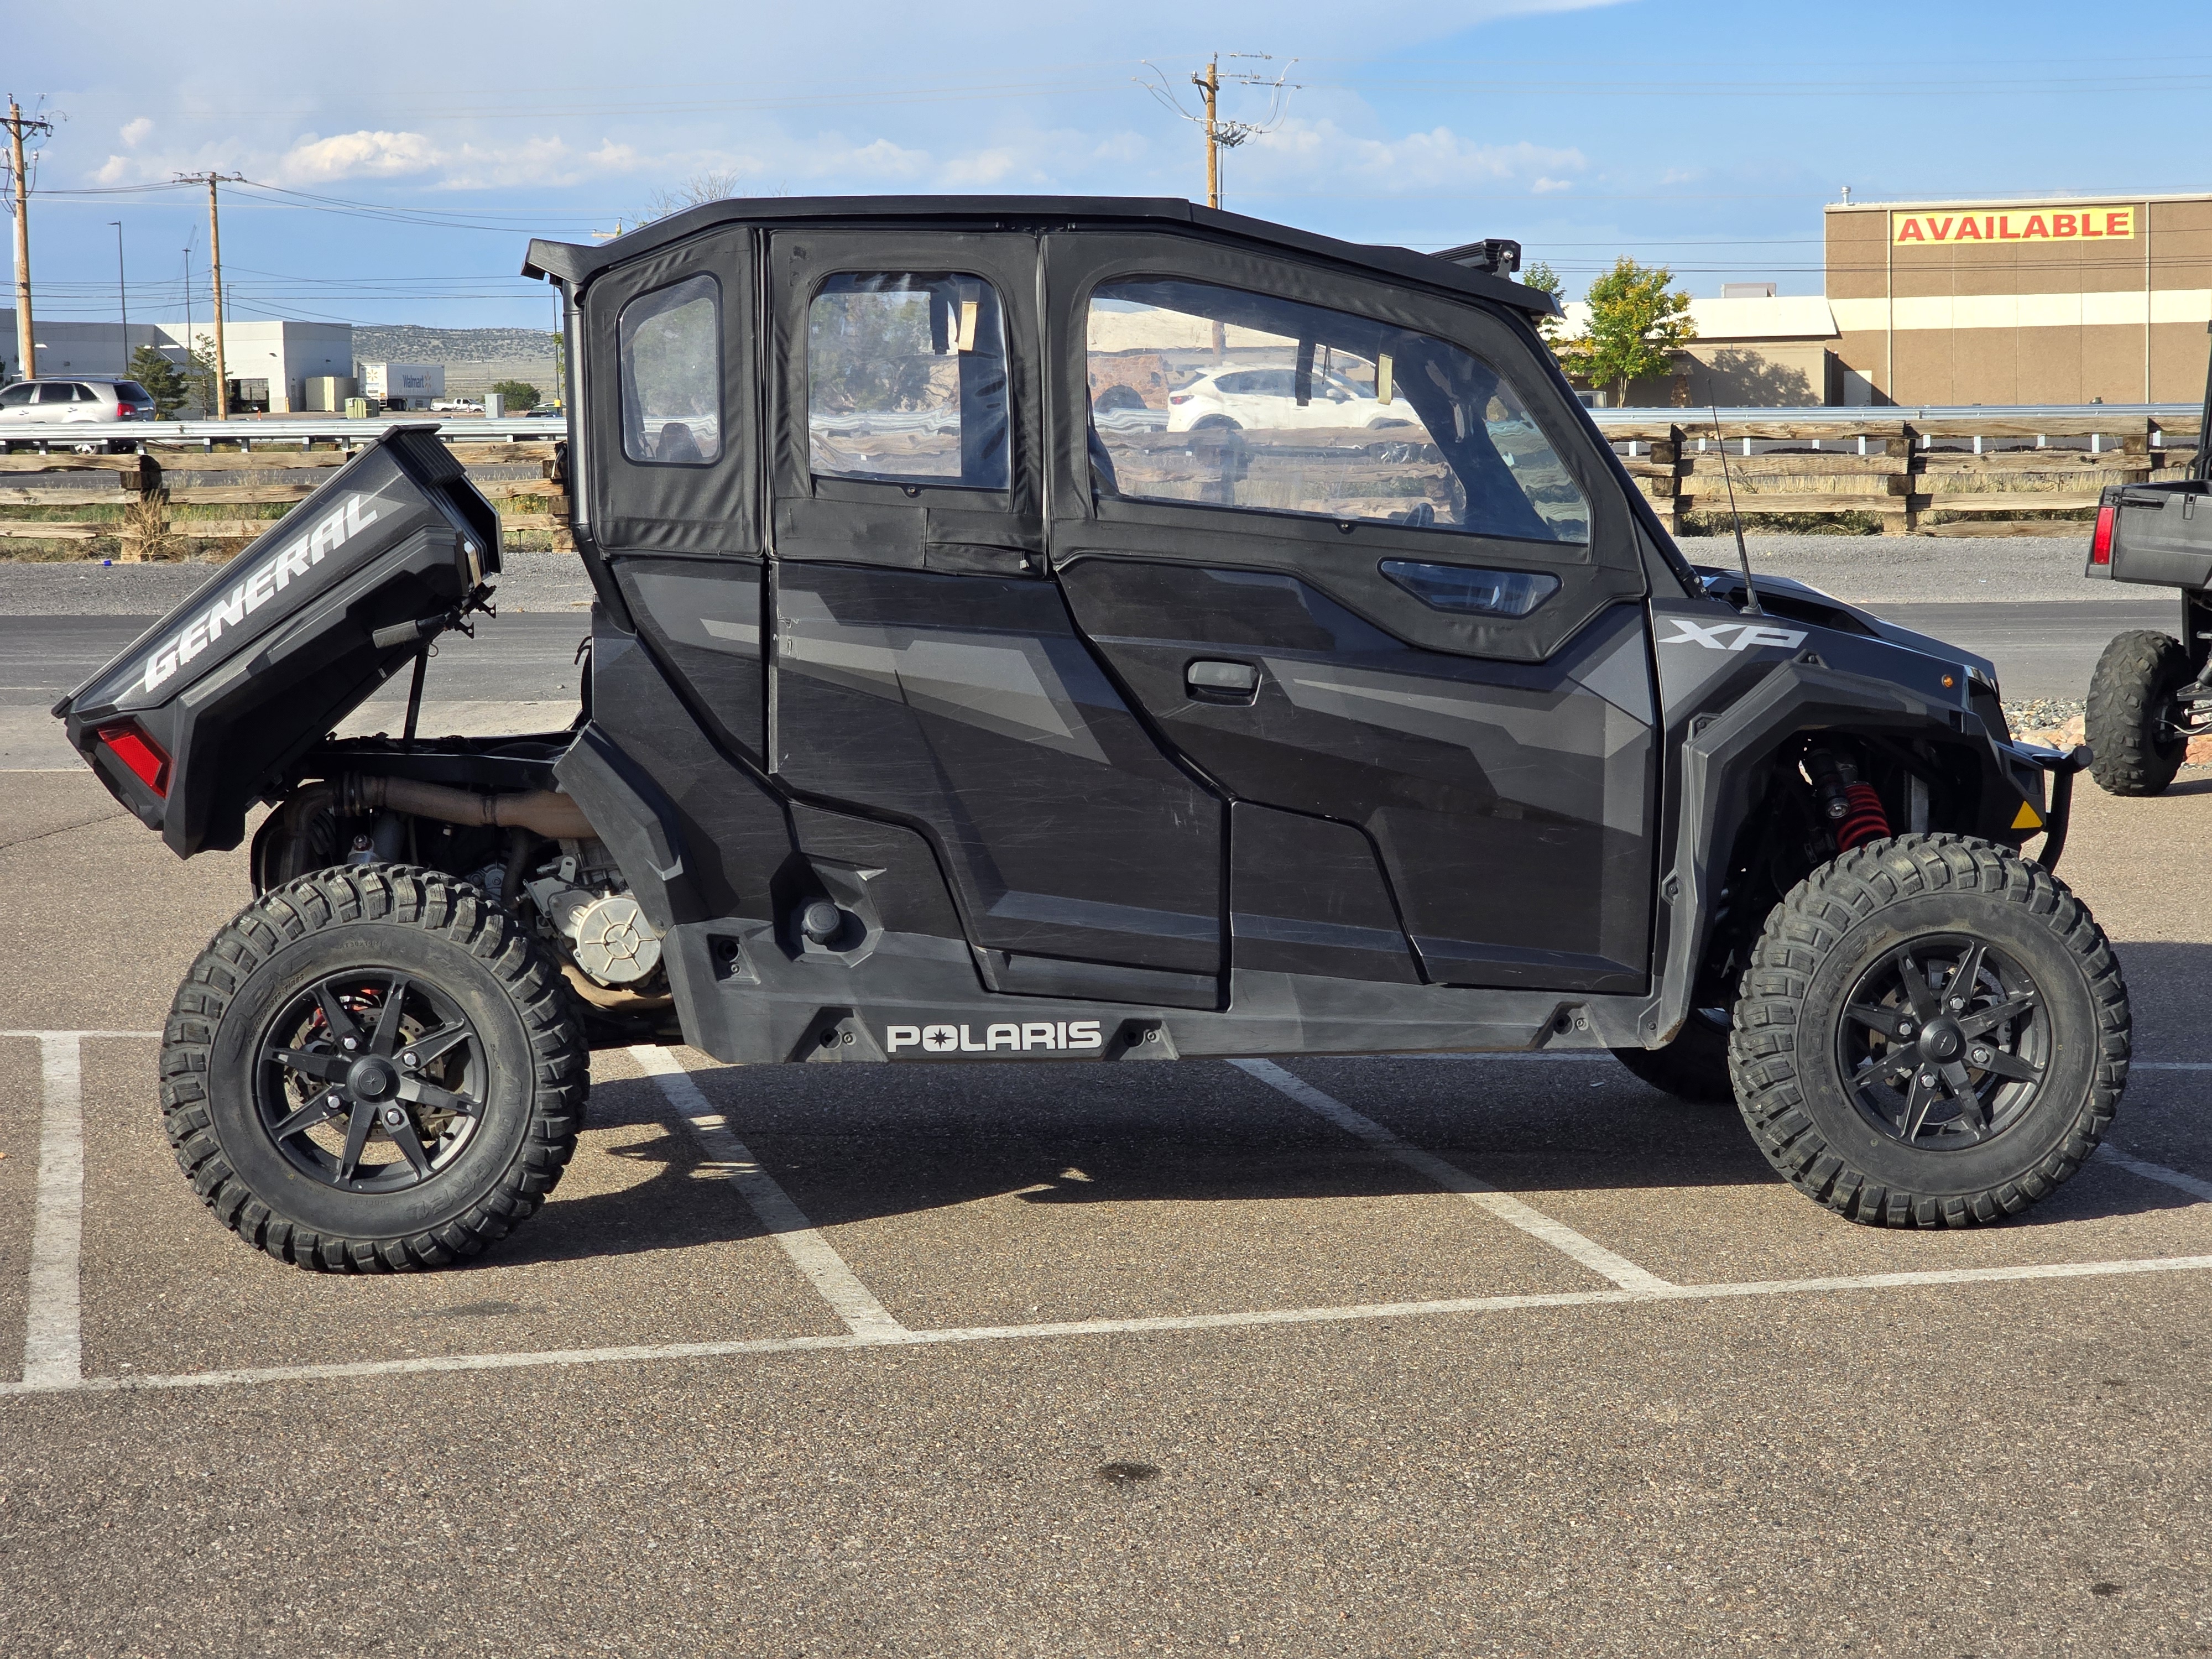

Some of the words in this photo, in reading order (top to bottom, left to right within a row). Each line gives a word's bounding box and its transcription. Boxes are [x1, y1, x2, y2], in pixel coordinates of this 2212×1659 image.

[1897, 212, 2130, 242] AVAILABLE
[403, 374, 424, 388] Walmart
[144, 495, 377, 693] GENERAL
[1657, 619, 1808, 650] XP
[281, 972, 306, 993] TIRES
[886, 1020, 1102, 1052] POLARIS
